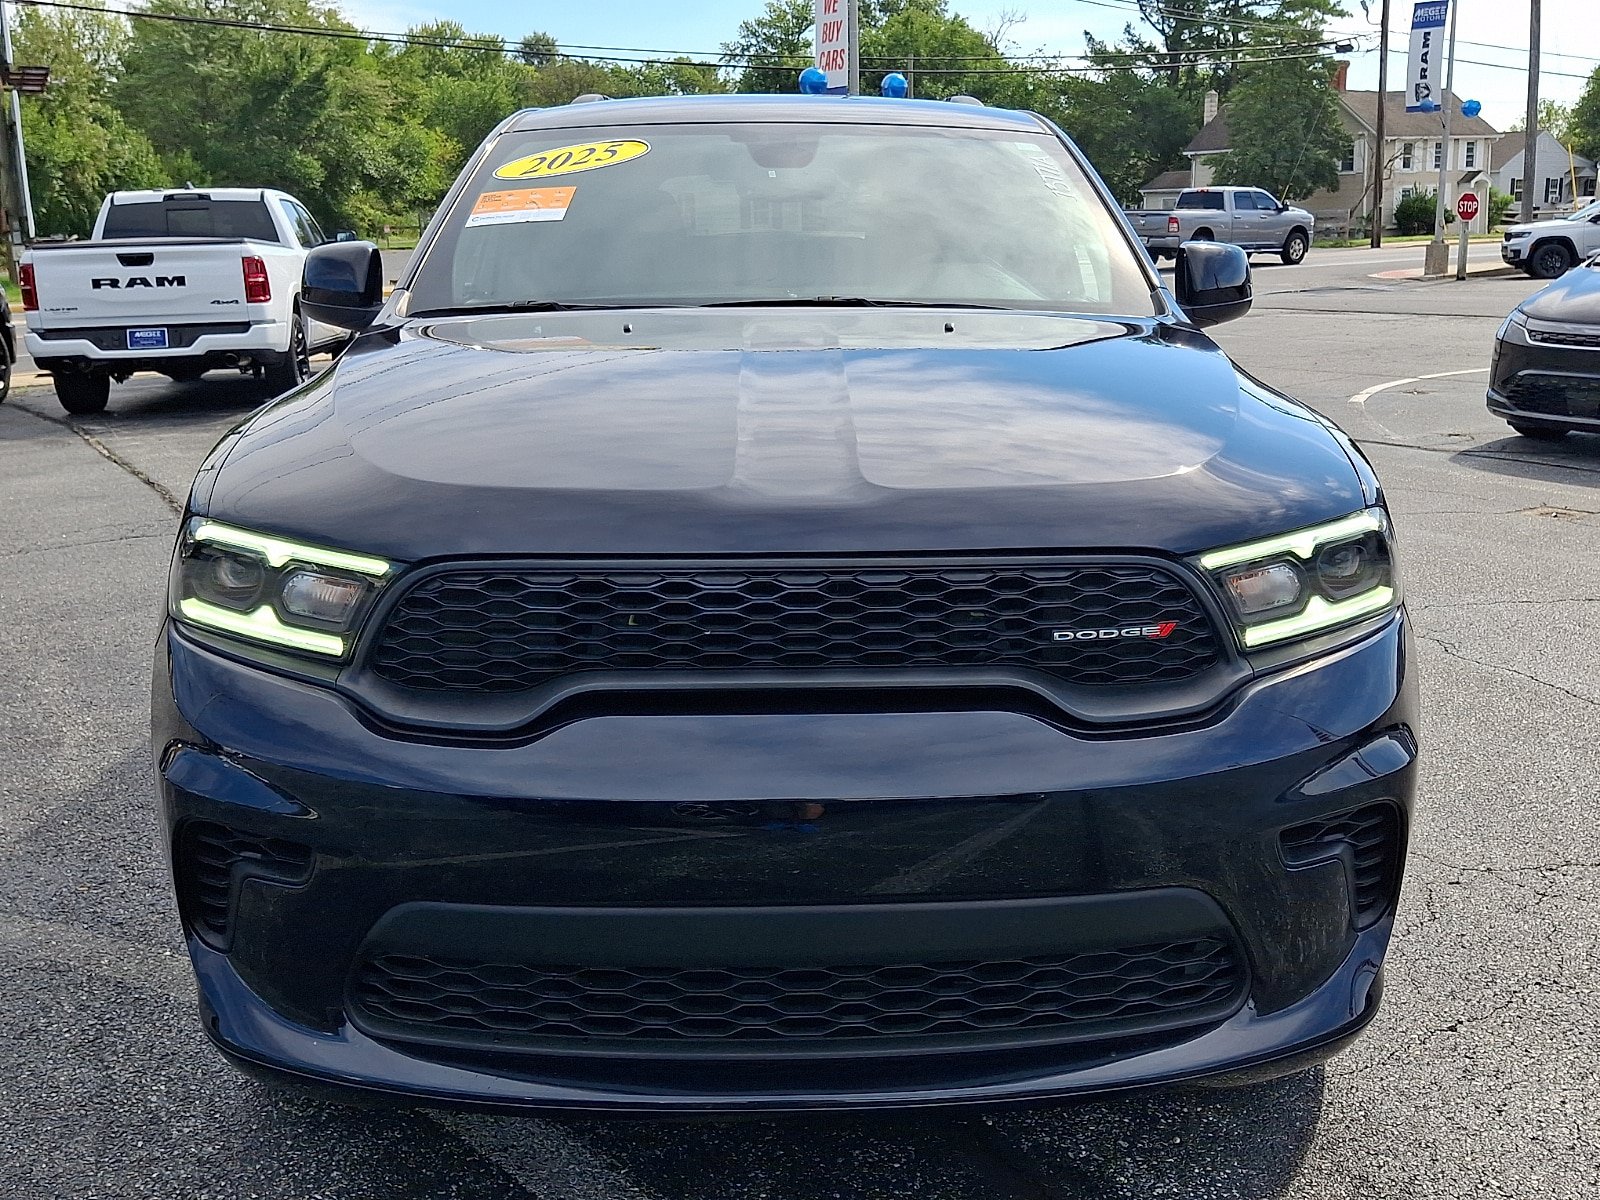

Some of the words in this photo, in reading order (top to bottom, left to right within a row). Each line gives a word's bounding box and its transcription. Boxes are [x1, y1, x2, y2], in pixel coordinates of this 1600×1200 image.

[823, 0, 838, 15] WE
[1414, 6, 1447, 17] MEGEE
[822, 20, 843, 44] BUY
[819, 48, 845, 72] CARS
[1420, 31, 1431, 80] RAM
[519, 143, 624, 176] 2025
[1458, 200, 1478, 213] STOP
[91, 275, 187, 290] RAM
[1053, 626, 1161, 641] DODGE
